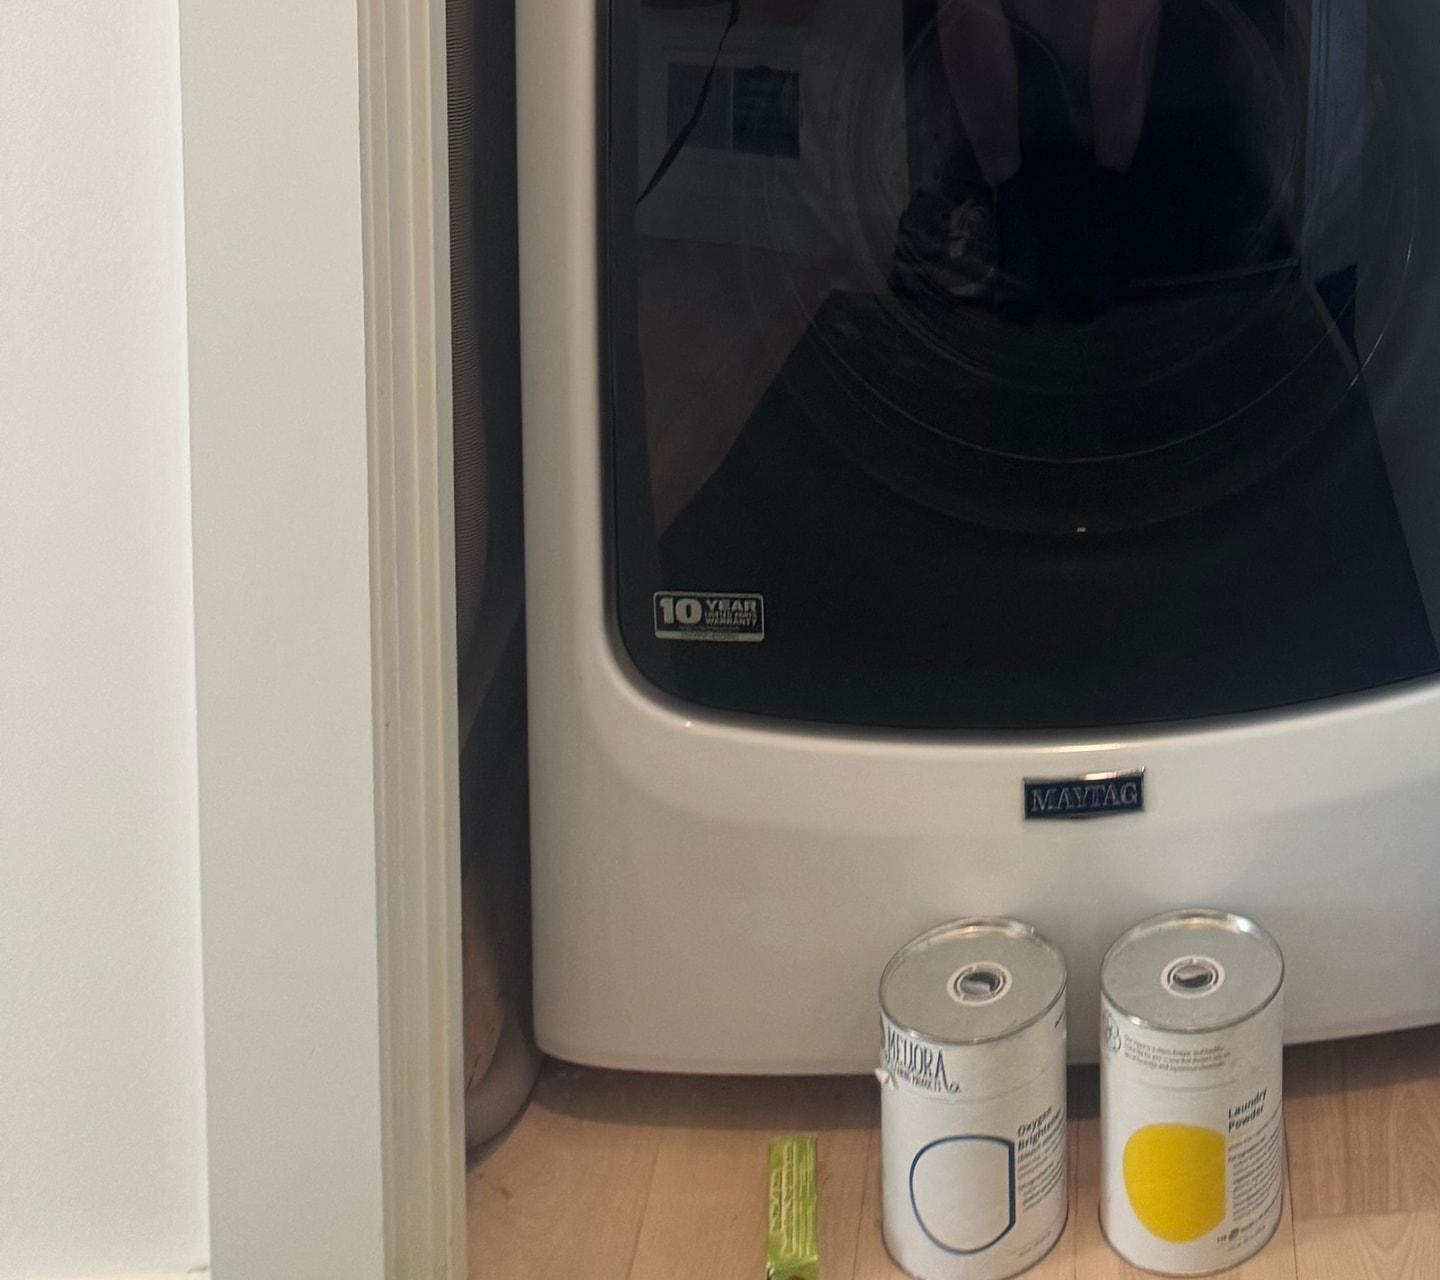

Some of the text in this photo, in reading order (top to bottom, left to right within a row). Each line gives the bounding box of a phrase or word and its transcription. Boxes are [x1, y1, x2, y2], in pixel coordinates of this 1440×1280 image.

[660, 597, 757, 625] 10 YEAR
[1031, 781, 1138, 813] MAYTAG
[1228, 1088, 1267, 1120] Laundry
[1228, 1103, 1264, 1133] Powder
[1017, 1106, 1052, 1138] Oxygen
